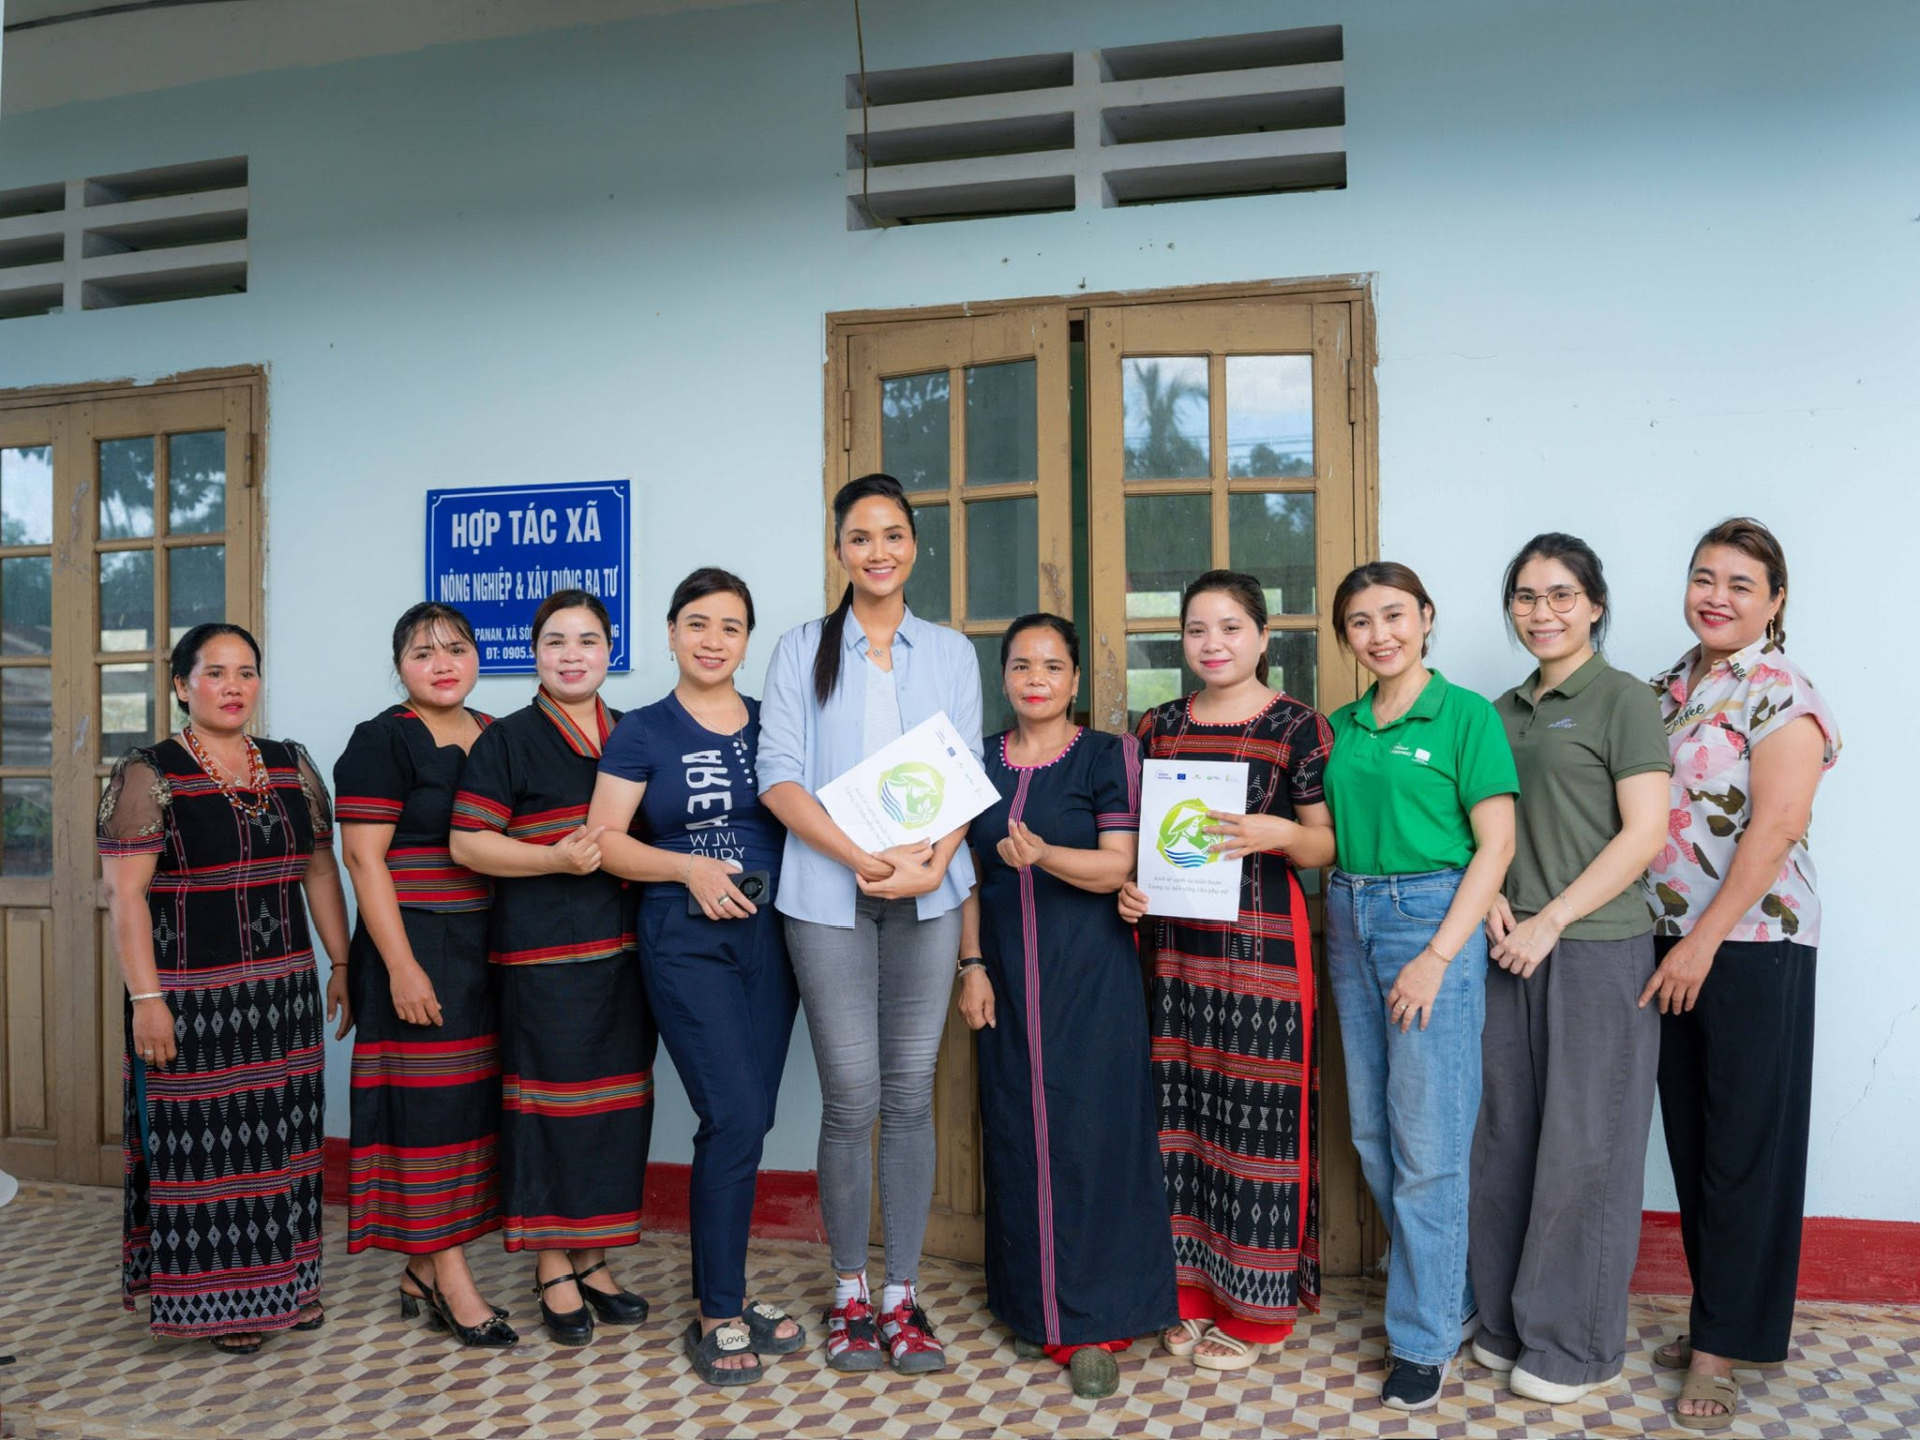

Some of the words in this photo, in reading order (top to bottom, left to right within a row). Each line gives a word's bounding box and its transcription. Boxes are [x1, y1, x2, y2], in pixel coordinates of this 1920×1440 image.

[452, 508, 501, 555] HỢP
[508, 502, 557, 545] TÁC
[565, 500, 601, 543] XÃ
[440, 568, 470, 603] NÔNG
[473, 565, 512, 607] NGHIỆP
[516, 571, 524, 600] &
[527, 565, 549, 600] XÂY
[585, 568, 601, 597] BA
[603, 565, 619, 597] TƯ
[506, 624, 517, 641] XÃ
[486, 646, 500, 660] ĐT:
[721, 1335, 746, 1346] LOVE
